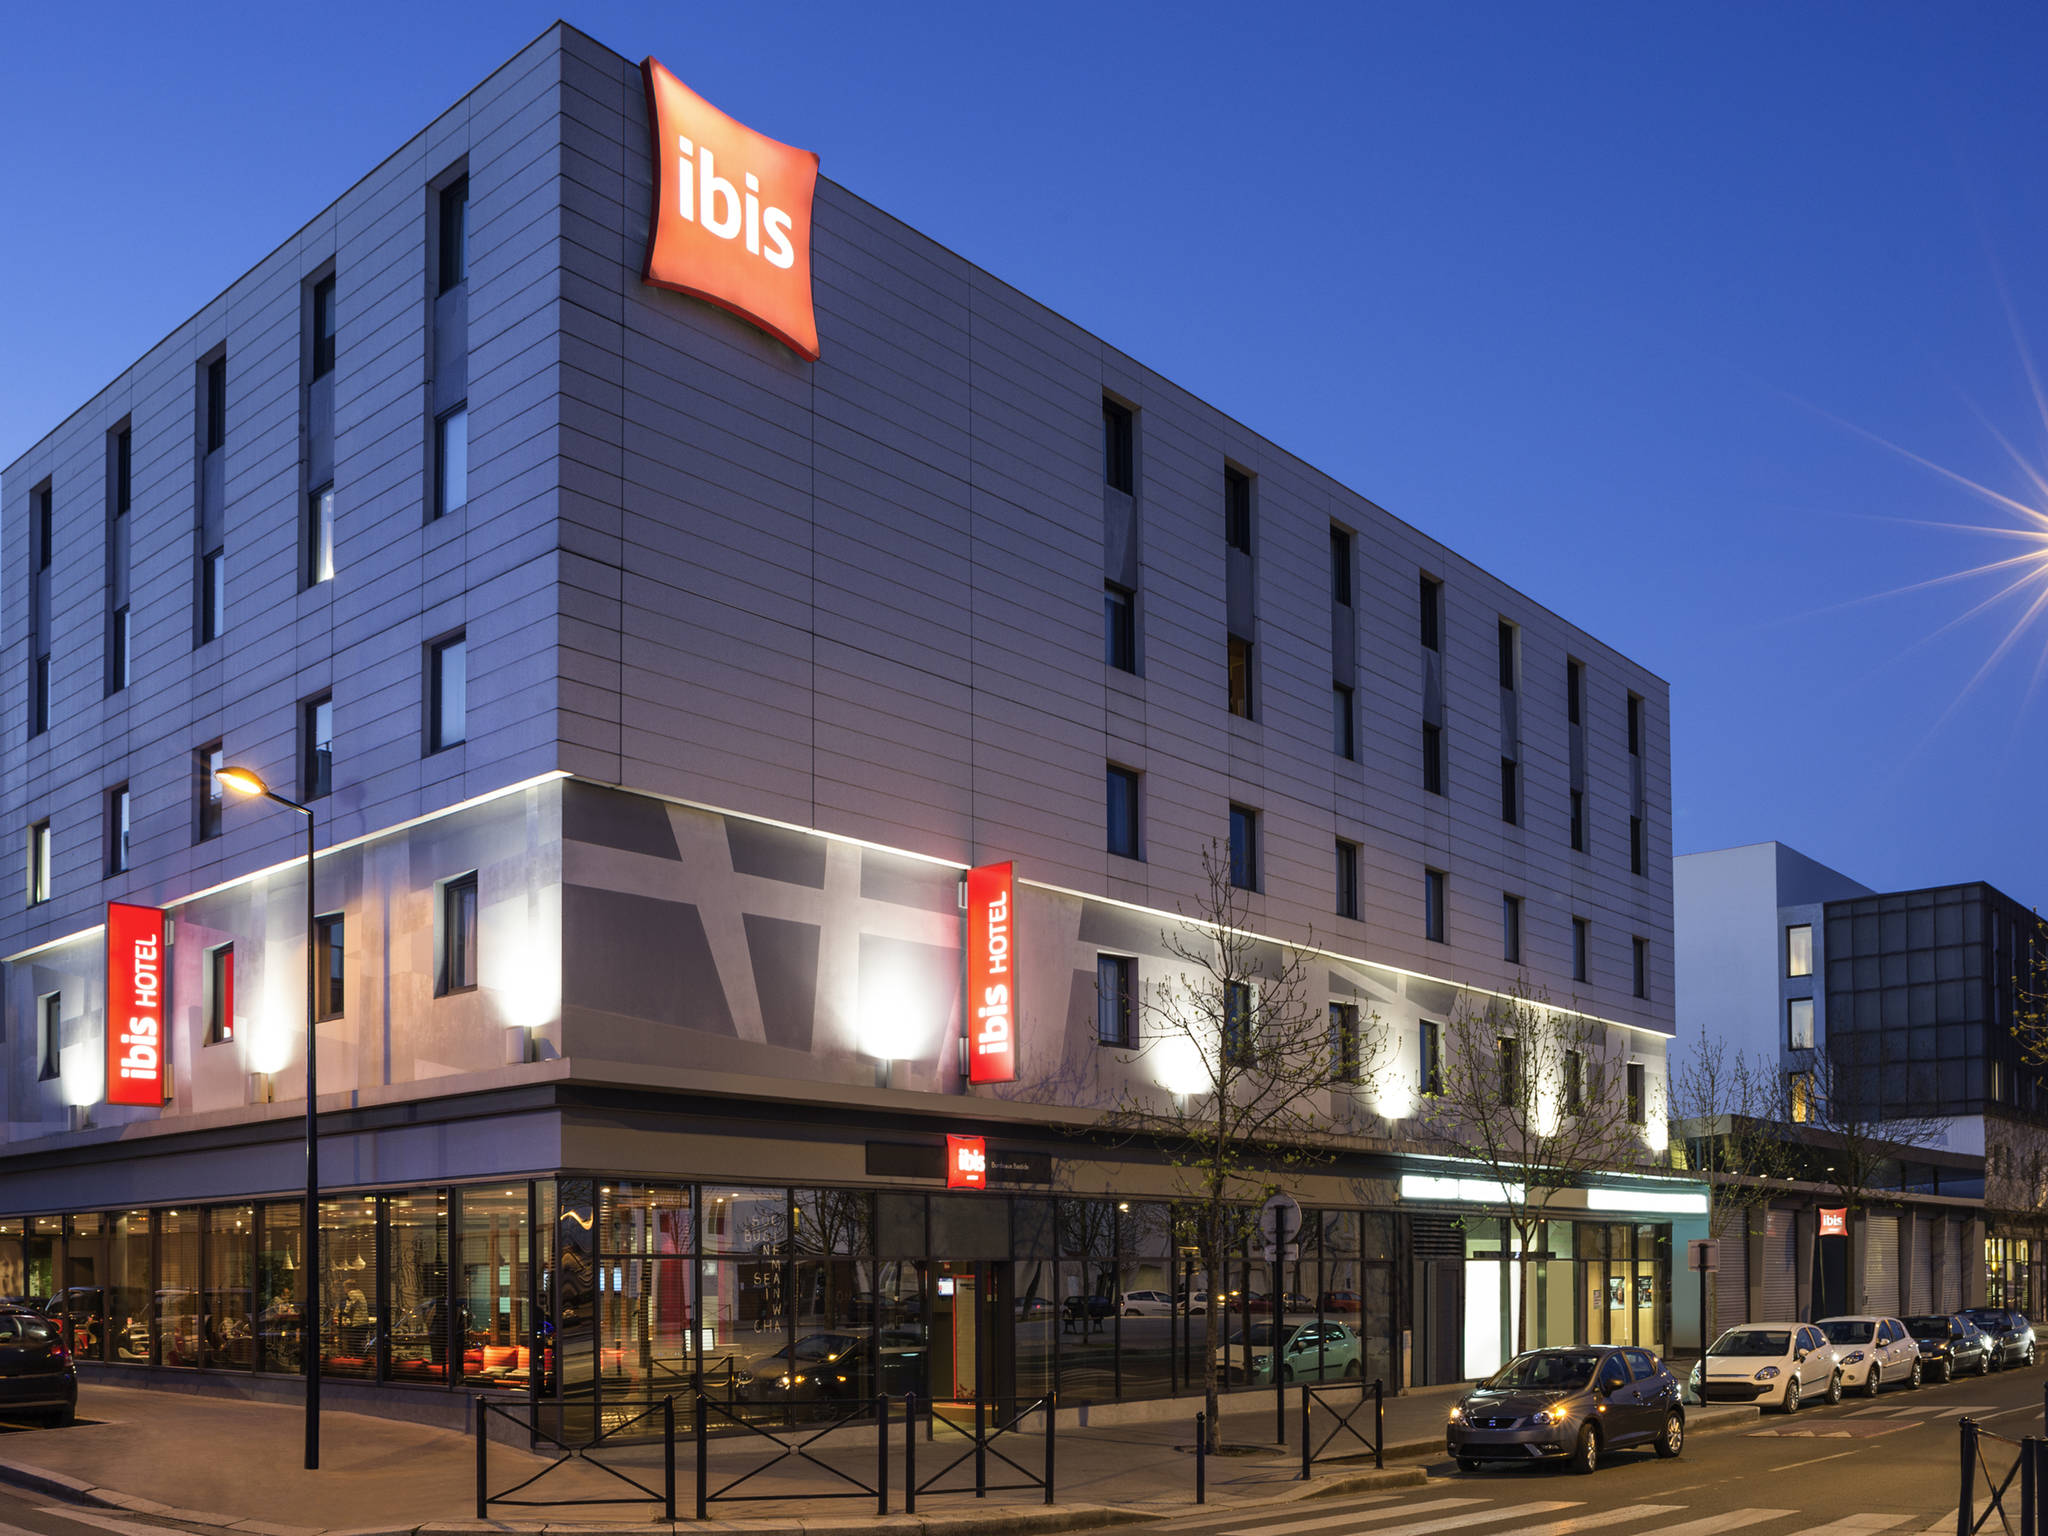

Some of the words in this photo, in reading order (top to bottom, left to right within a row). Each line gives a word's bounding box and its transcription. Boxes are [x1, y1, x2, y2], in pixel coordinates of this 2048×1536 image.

[679, 135, 795, 269] ibis
[989, 891, 1007, 974] HOTEL
[135, 934, 157, 1007] HOTEL
[120, 1017, 157, 1079] ibis
[978, 983, 1008, 1055] ibis
[1823, 1214, 1843, 1226] ibis
